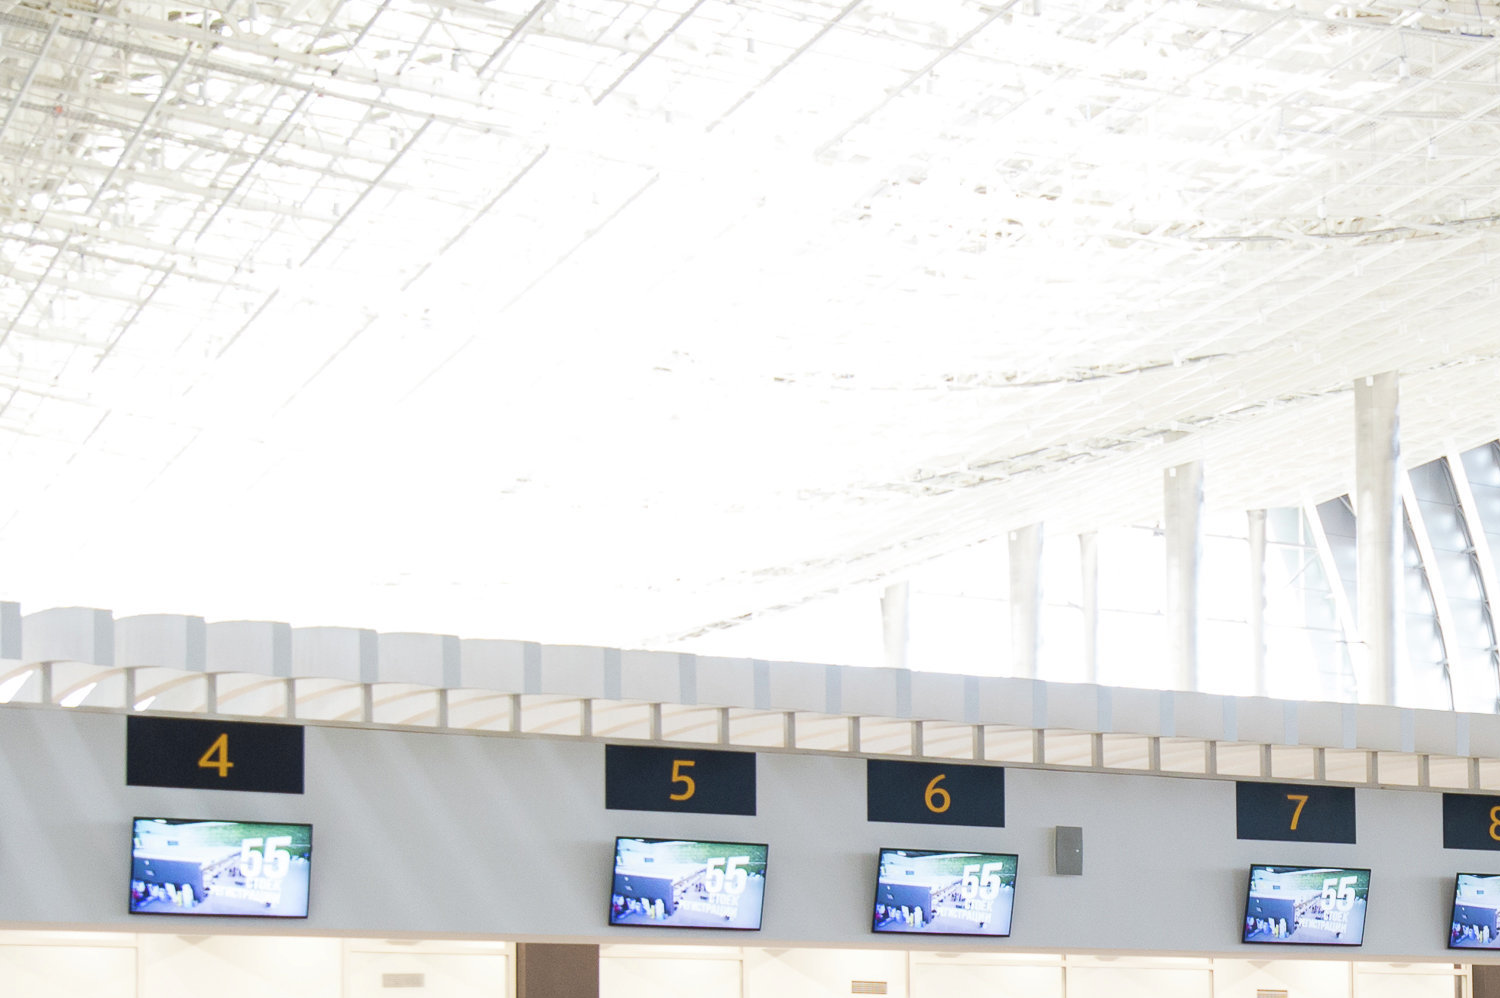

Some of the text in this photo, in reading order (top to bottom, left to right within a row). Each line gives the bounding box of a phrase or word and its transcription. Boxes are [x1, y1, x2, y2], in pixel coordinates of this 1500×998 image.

[198, 732, 234, 778] 4
[669, 759, 696, 801] 5
[924, 773, 951, 814] 6
[1287, 794, 1309, 831] 7
[240, 836, 291, 879] 55
[705, 856, 750, 895] 55
[961, 862, 1003, 900] 55
[1320, 876, 1358, 912] 55
